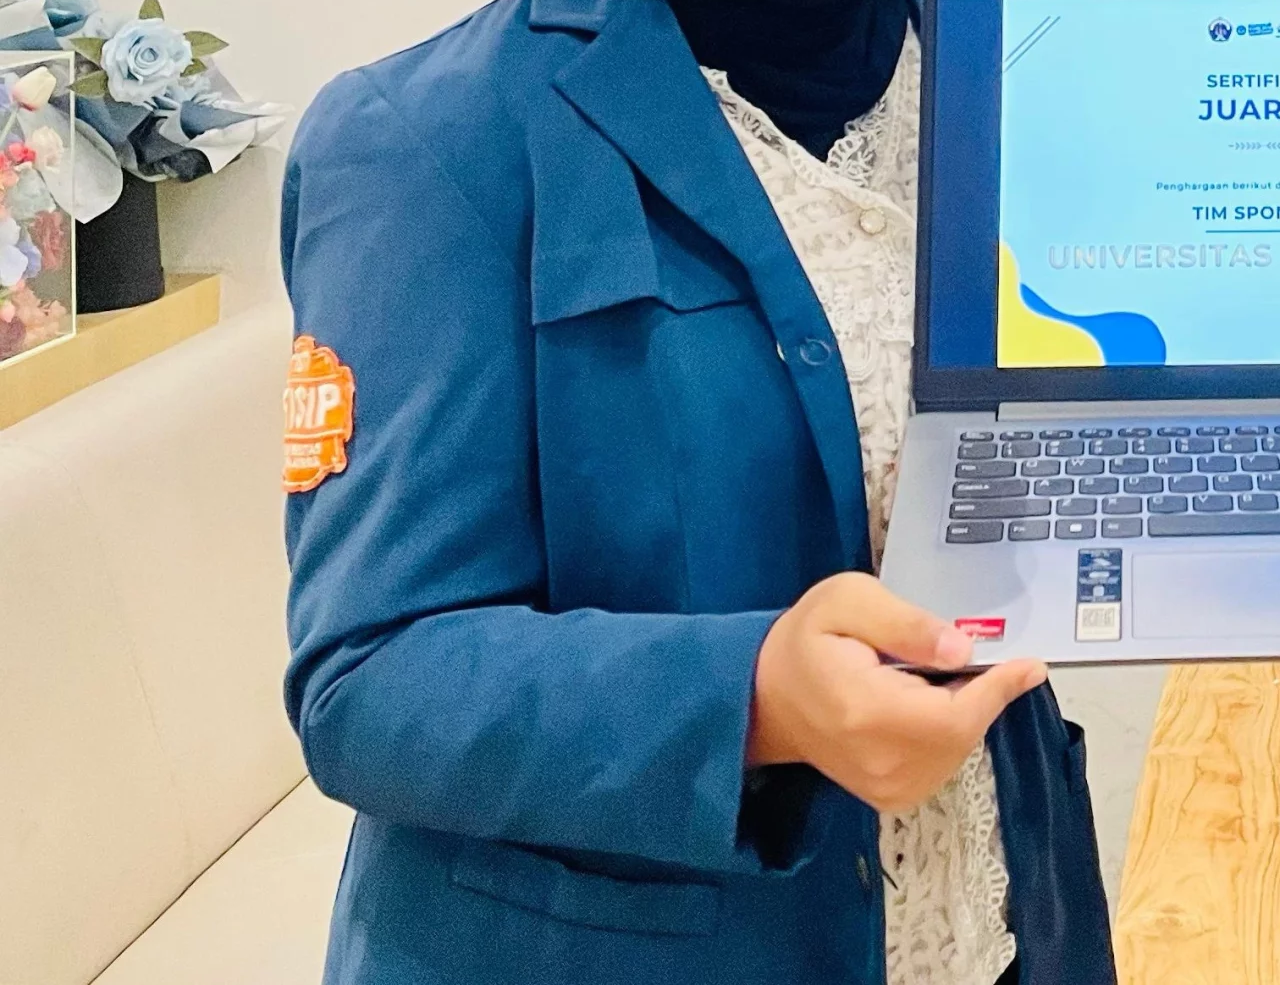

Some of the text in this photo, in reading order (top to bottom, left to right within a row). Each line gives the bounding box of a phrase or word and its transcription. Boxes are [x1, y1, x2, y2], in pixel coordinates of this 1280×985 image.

[1156, 182, 1229, 192] Penghargaan
[1232, 182, 1271, 190] berikut
[1192, 205, 1227, 221] TIM
[1048, 243, 1273, 270] UNIVERSITAS
